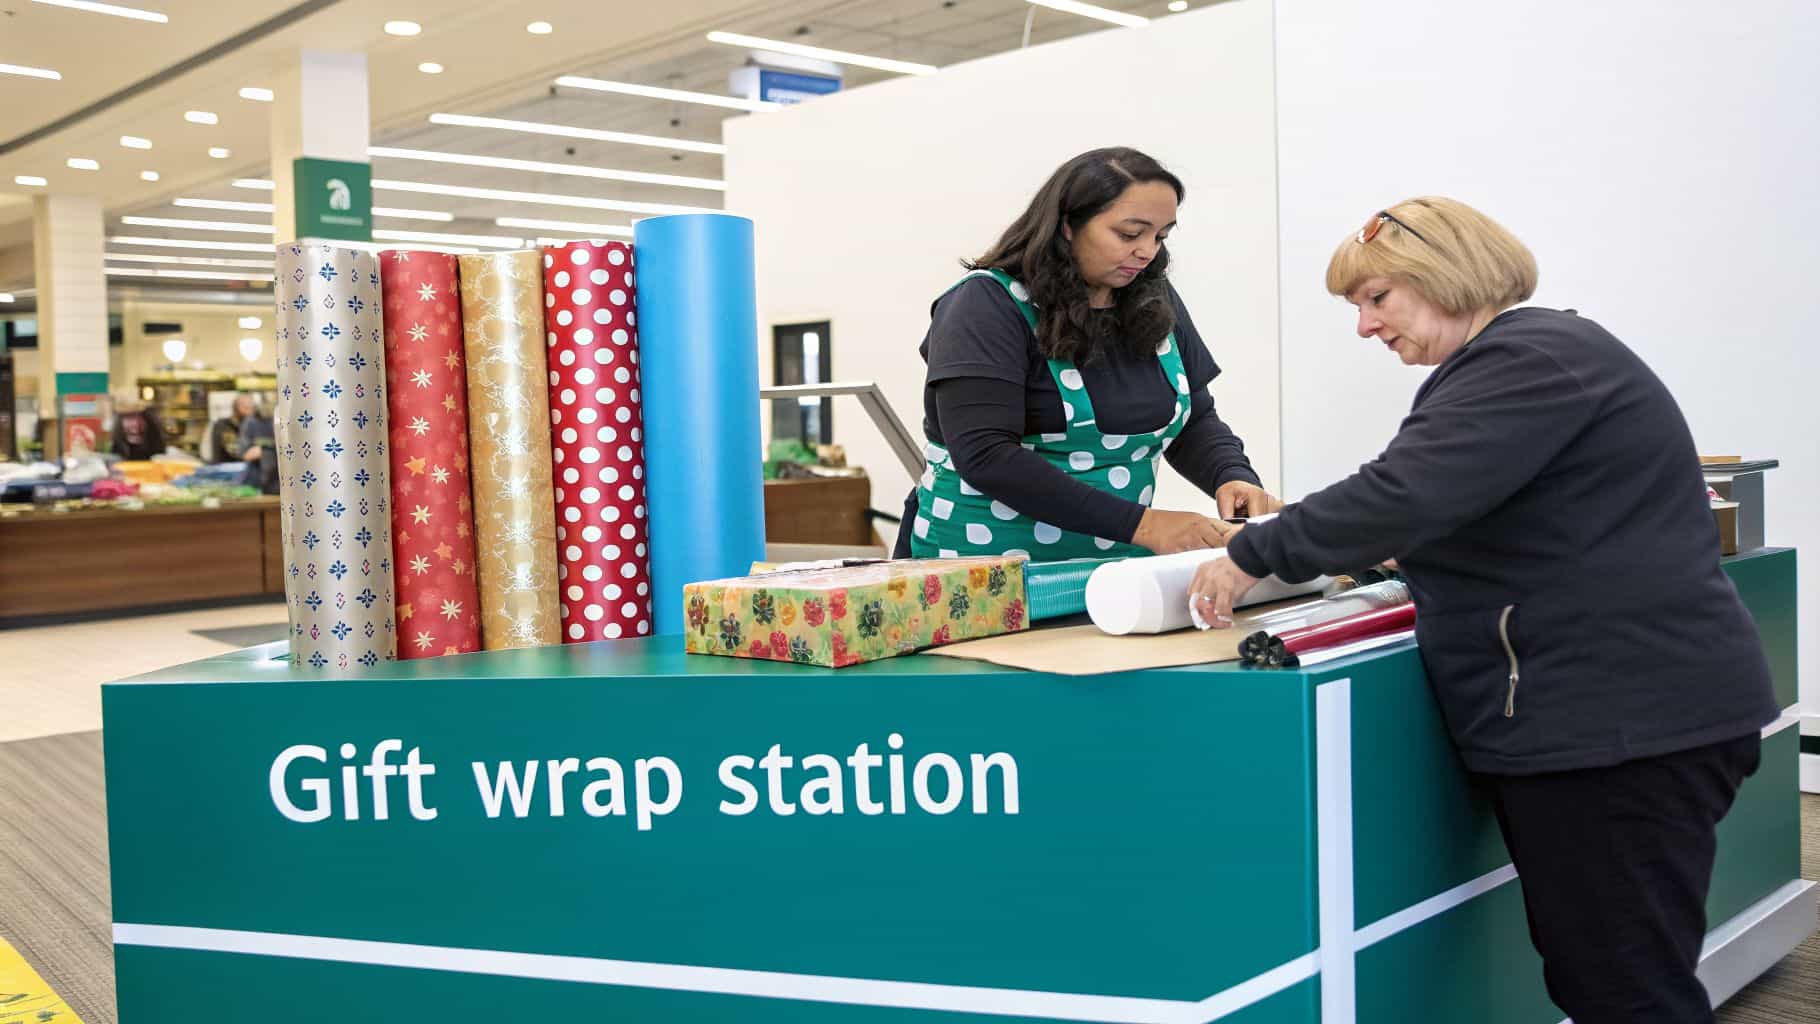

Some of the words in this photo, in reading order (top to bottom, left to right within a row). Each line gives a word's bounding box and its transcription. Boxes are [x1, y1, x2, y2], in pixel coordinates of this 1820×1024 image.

[269, 738, 438, 823] Gift
[471, 756, 683, 831] wrap
[718, 732, 1020, 816] station
